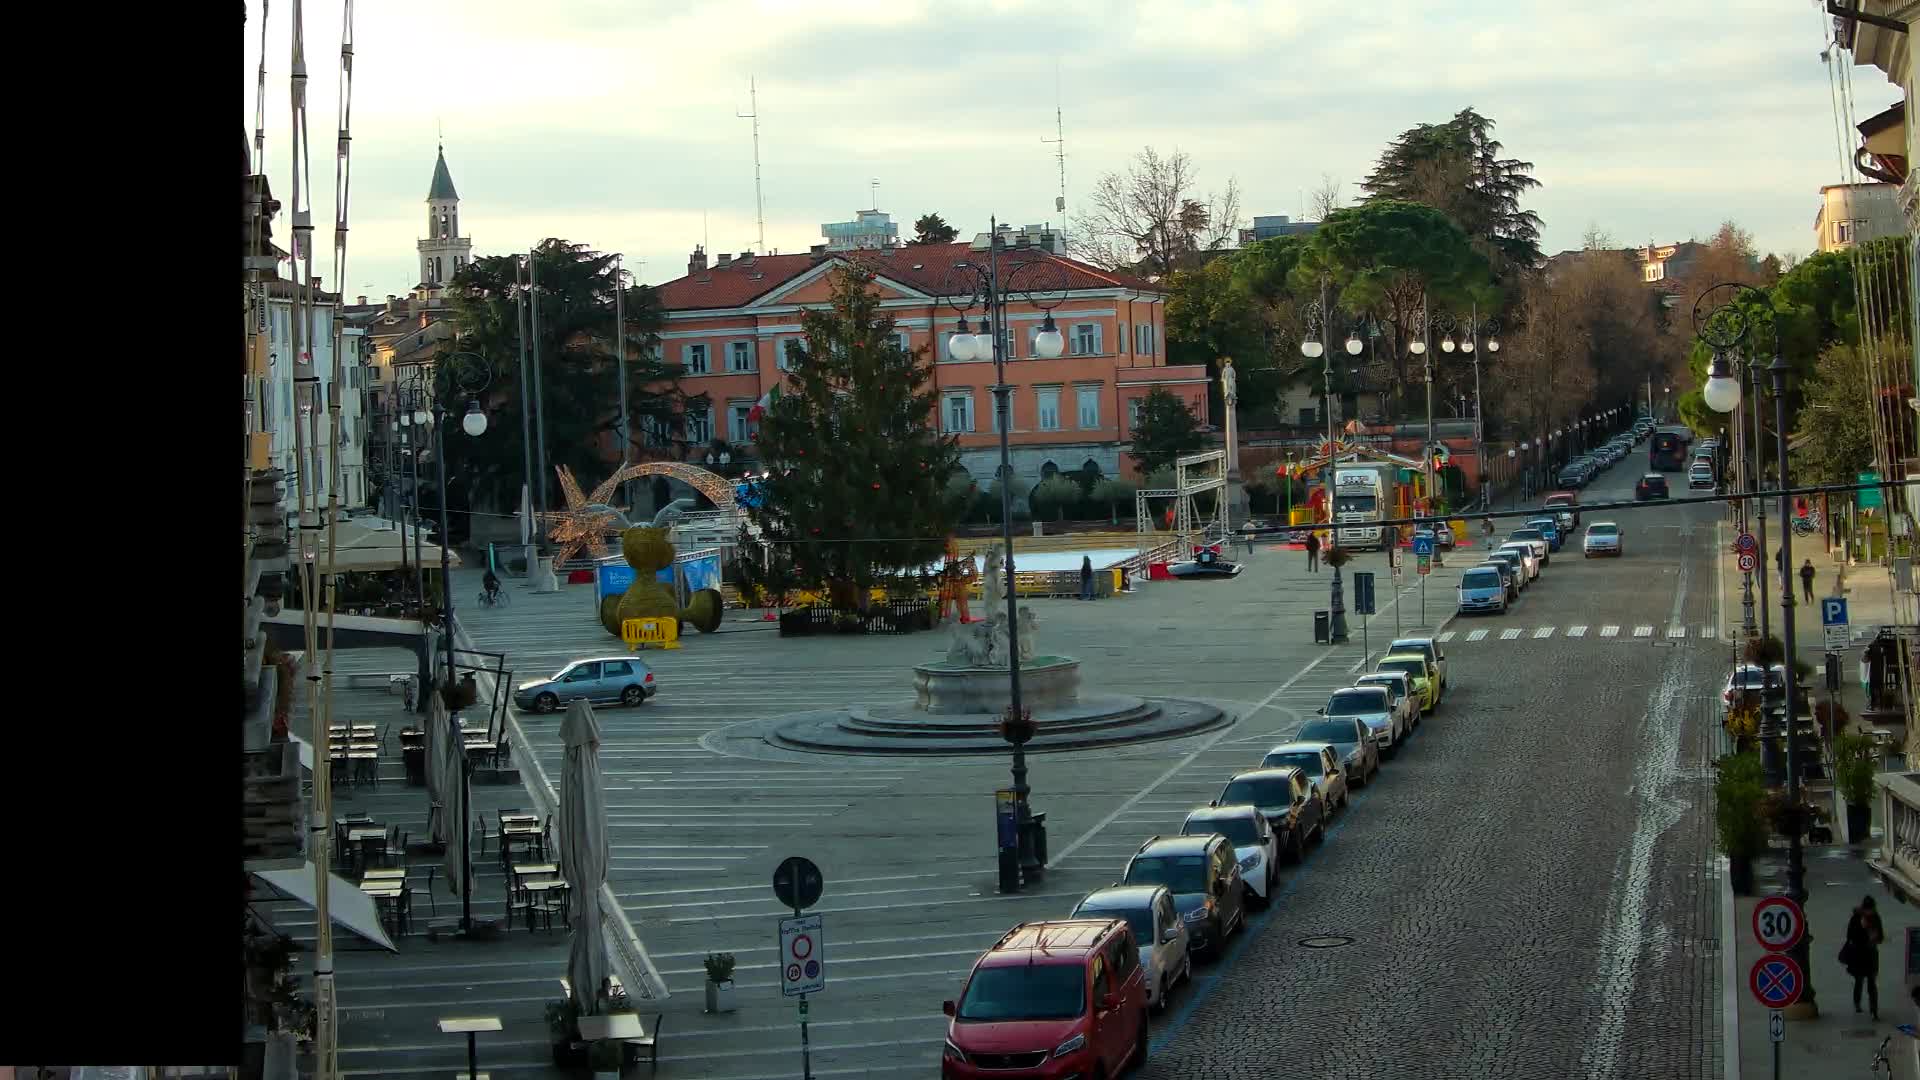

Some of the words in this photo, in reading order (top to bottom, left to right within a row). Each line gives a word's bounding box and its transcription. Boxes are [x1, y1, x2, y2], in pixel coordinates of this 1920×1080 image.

[1742, 557, 1753, 567] 20
[1826, 601, 1842, 621] P
[1762, 911, 1792, 938] 30
